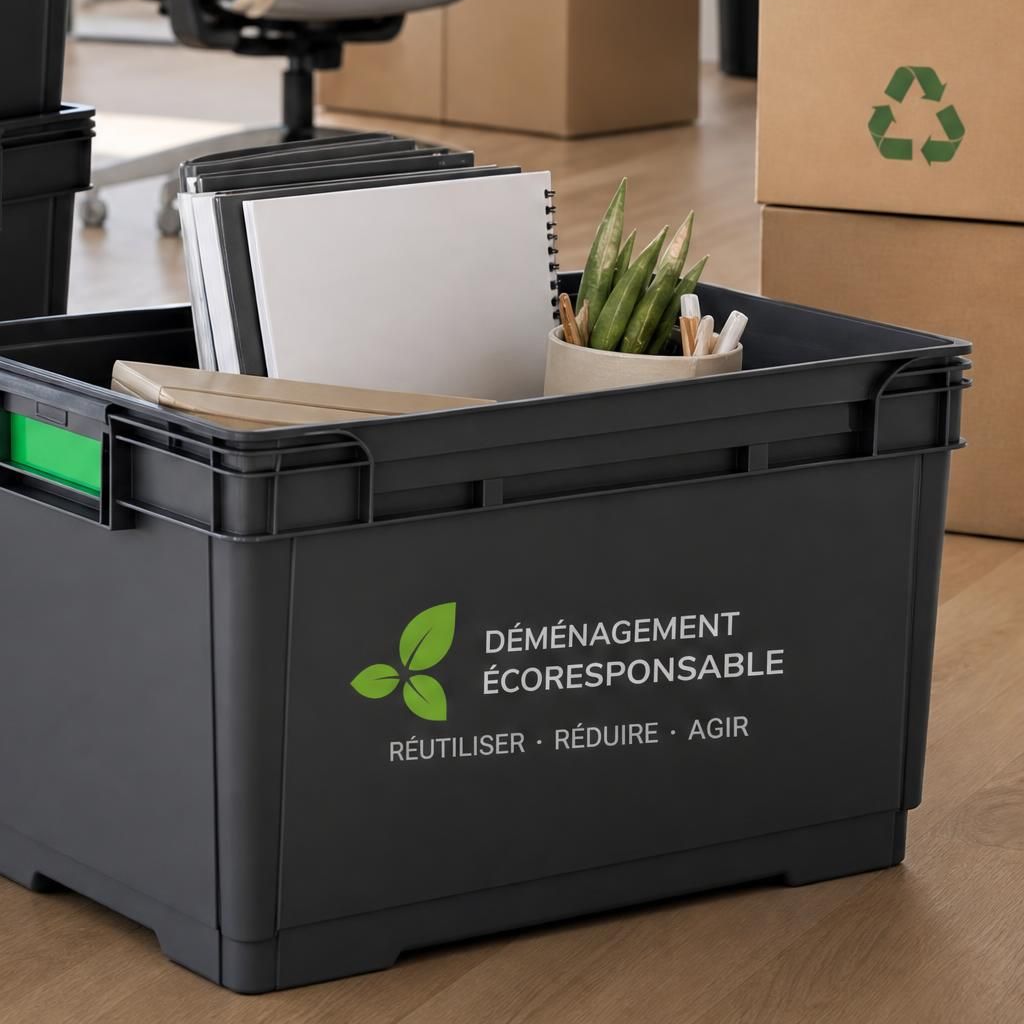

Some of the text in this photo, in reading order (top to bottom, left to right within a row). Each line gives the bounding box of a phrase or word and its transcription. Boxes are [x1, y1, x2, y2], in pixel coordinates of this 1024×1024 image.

[484, 611, 741, 655] DÉMÉNAGEMENT
[482, 649, 785, 695] ÉCORESPONSABLE
[389, 732, 526, 762] RÉUTILISER
[554, 722, 660, 750] RÉDUIRE
[688, 715, 750, 741] AGIR
